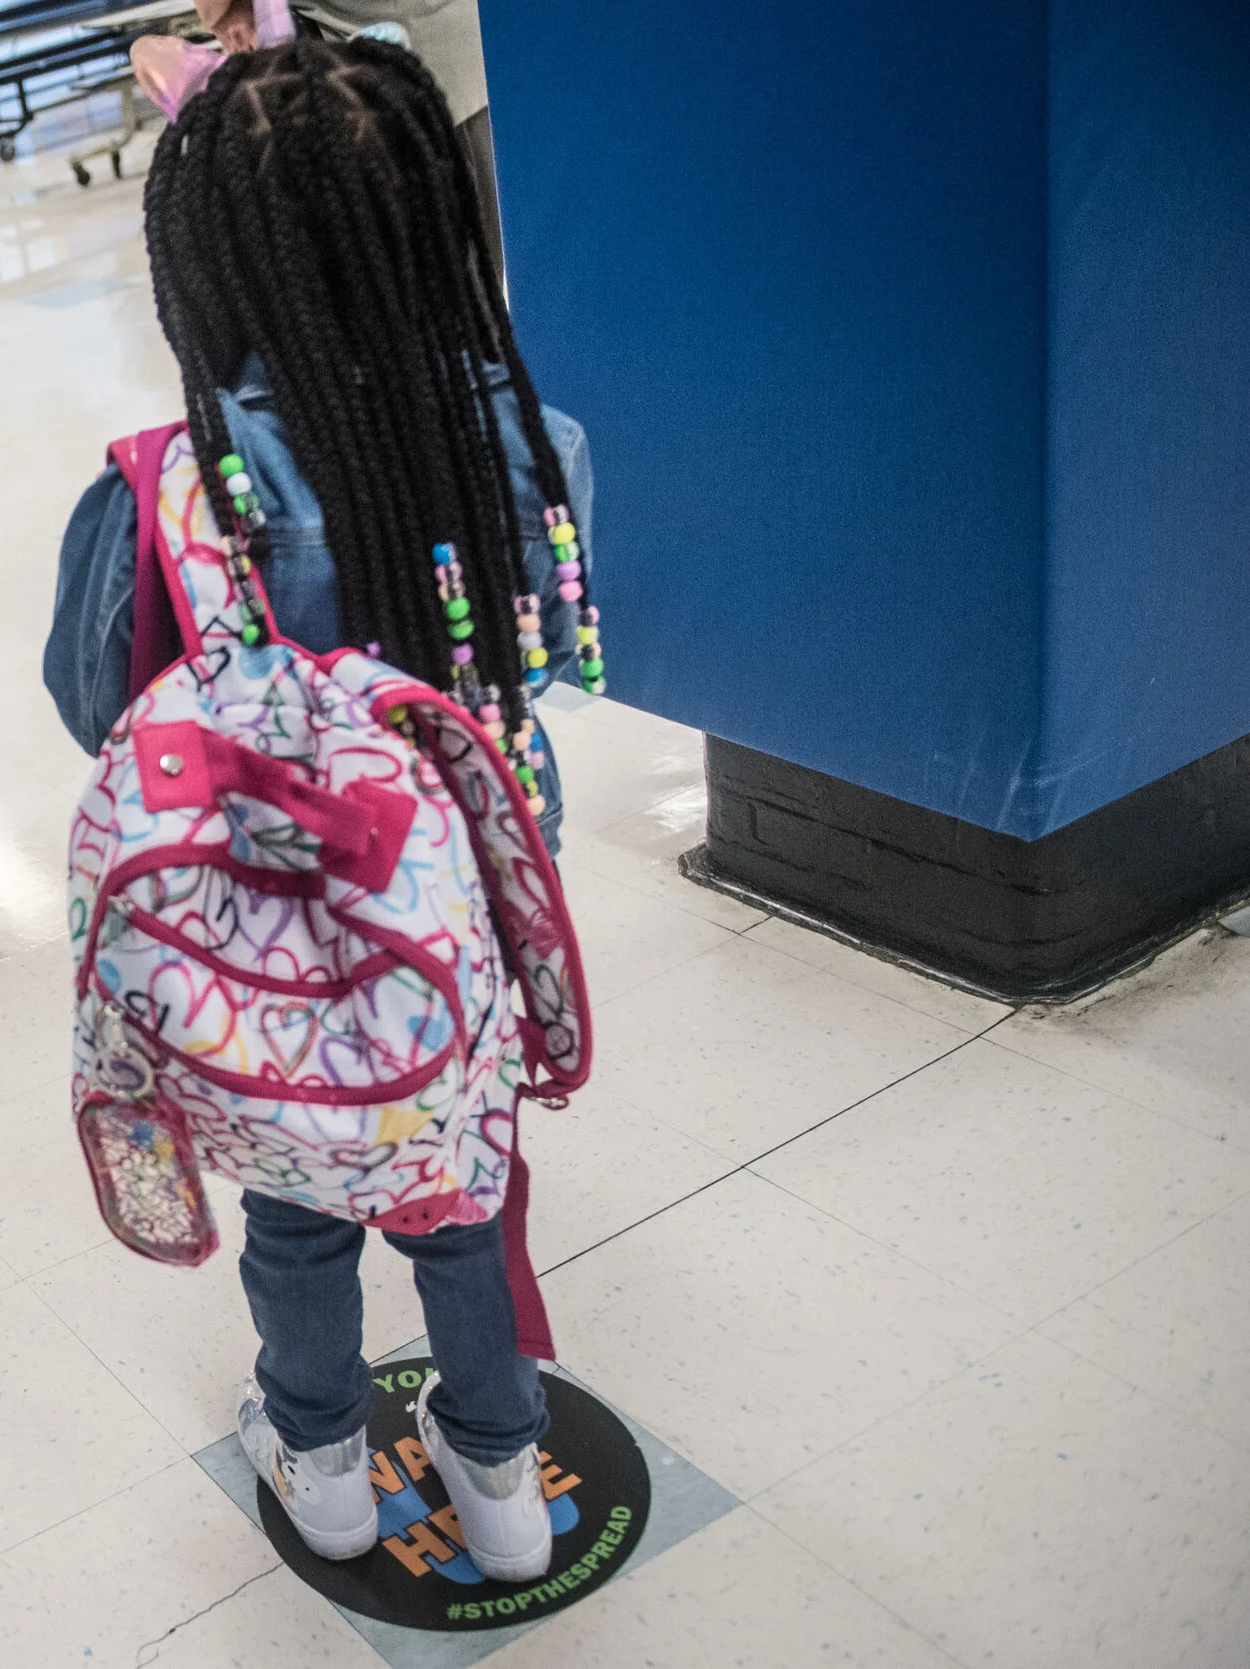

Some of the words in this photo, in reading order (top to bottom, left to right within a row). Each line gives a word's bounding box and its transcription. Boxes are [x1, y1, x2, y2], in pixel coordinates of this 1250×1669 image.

[372, 1367, 435, 1393] YO
[369, 1436, 432, 1502] WA
[382, 1451, 583, 1577] HE
[446, 1505, 632, 1620] #STOPTHESPREAD
